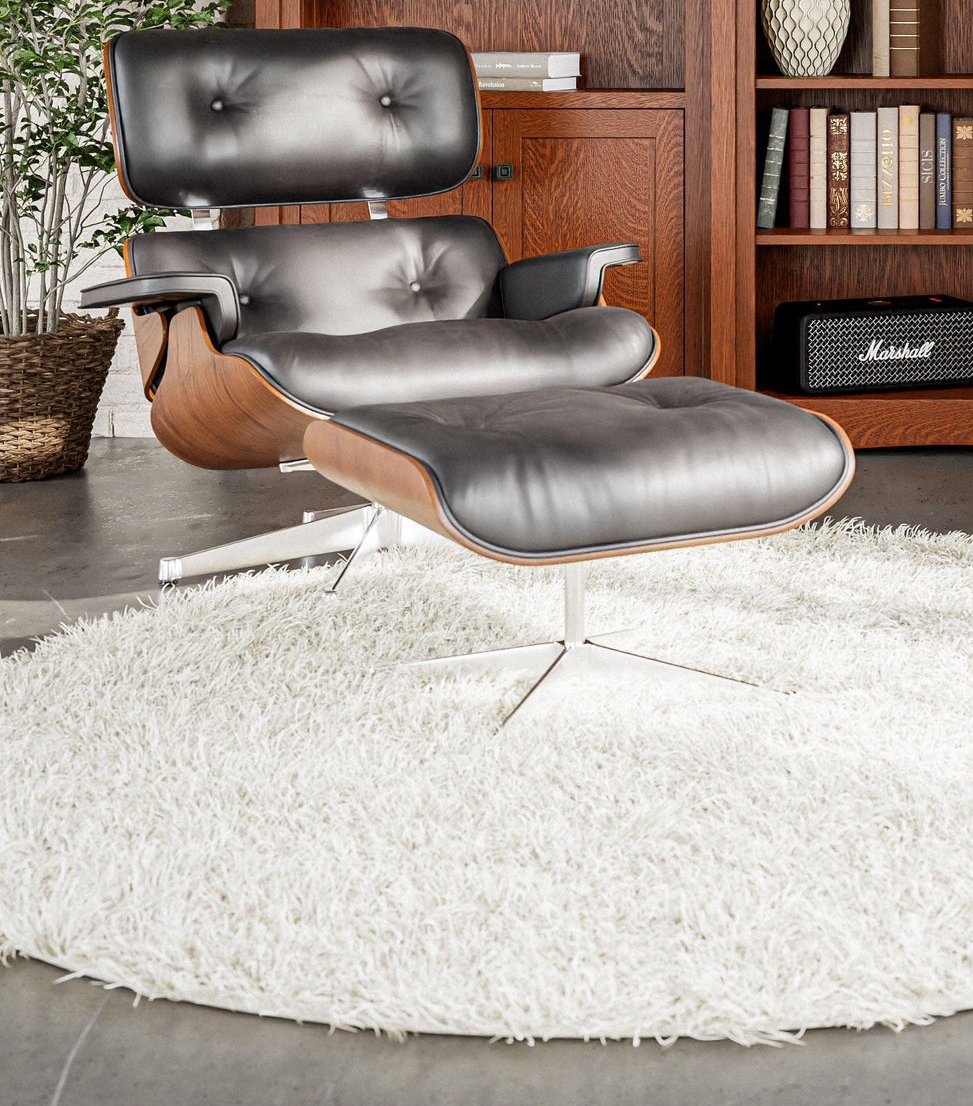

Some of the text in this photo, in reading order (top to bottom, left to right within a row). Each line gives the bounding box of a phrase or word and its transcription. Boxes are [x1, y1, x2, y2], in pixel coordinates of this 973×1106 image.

[920, 150, 933, 184] SICIS
[938, 138, 947, 206] JUMBO COLLECTION
[858, 340, 936, 363] Marshall
